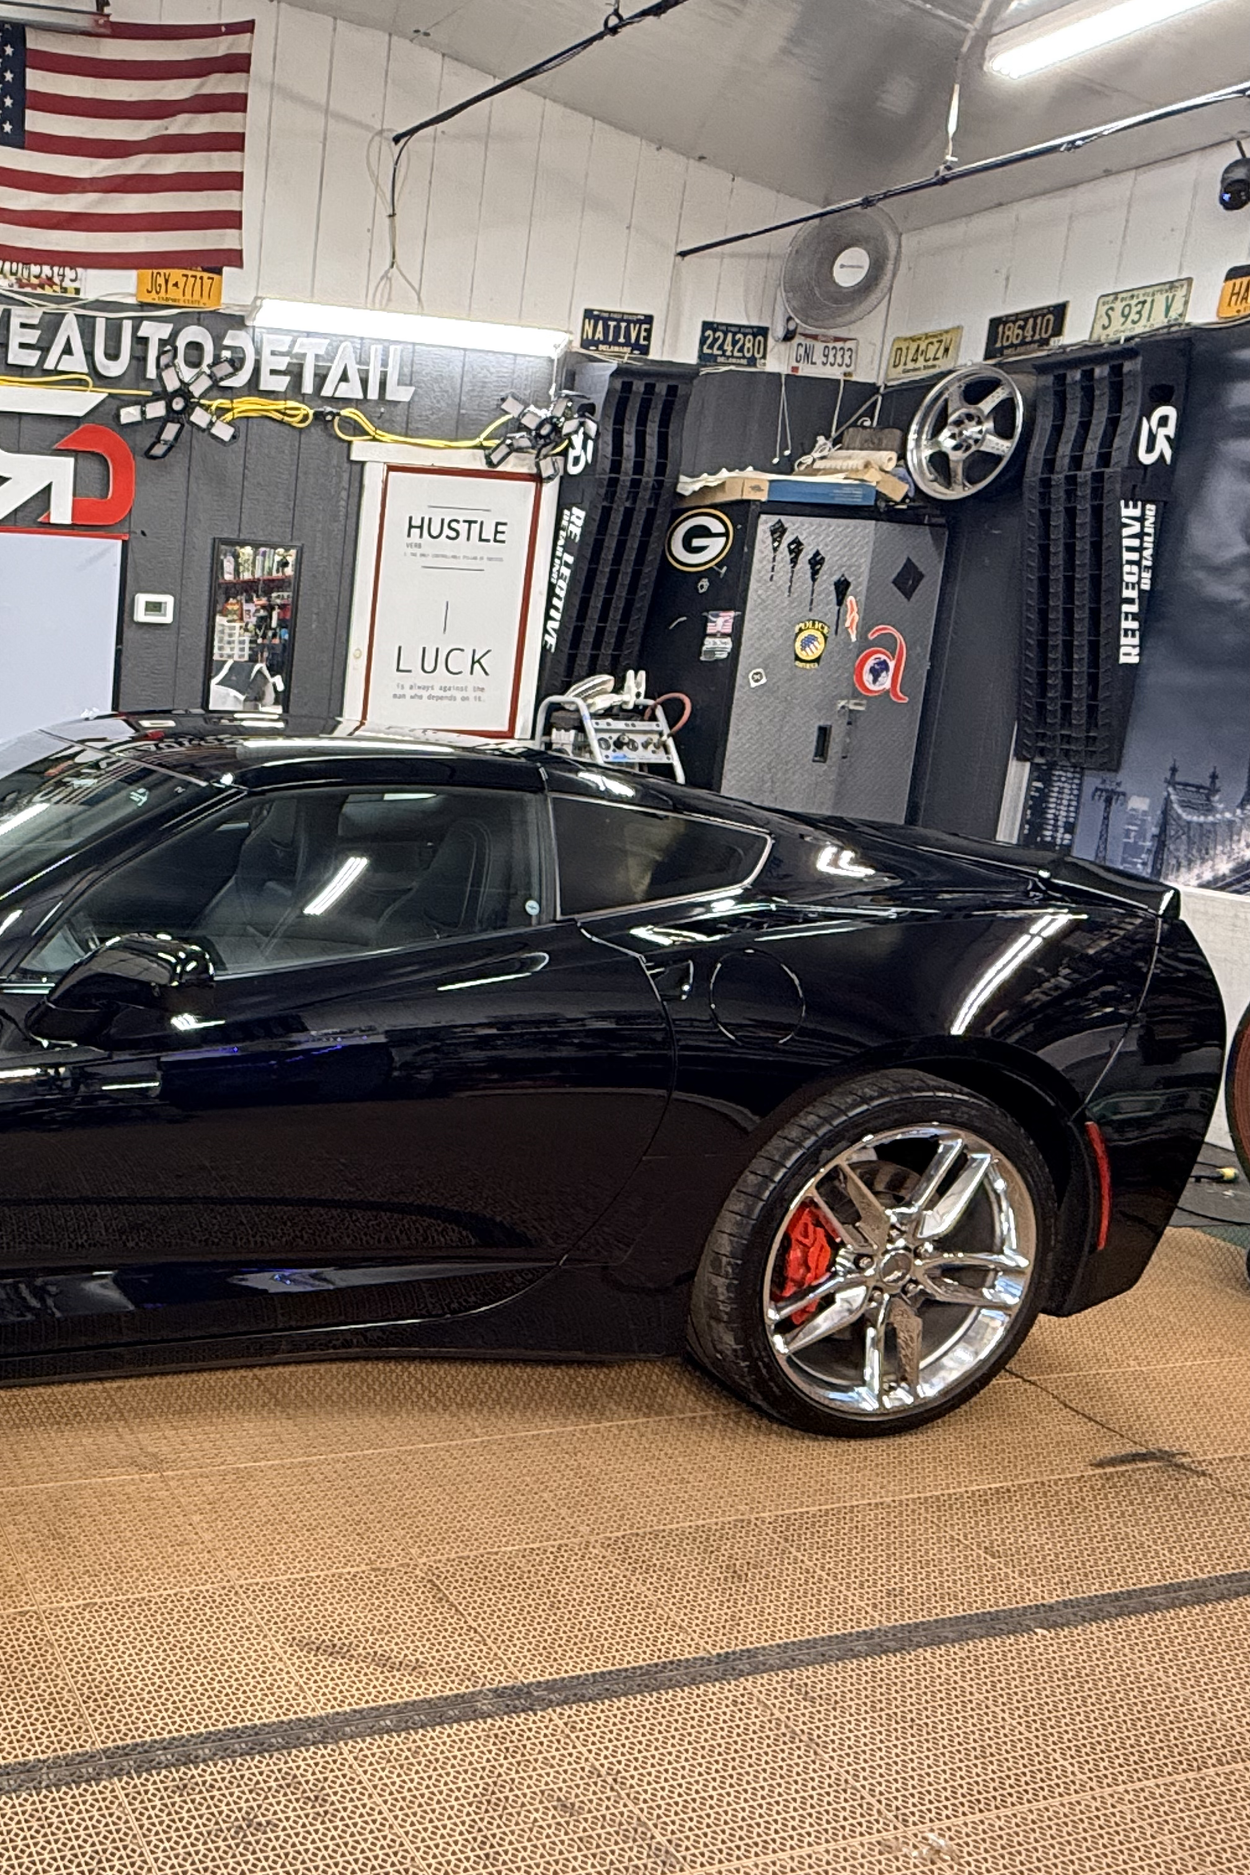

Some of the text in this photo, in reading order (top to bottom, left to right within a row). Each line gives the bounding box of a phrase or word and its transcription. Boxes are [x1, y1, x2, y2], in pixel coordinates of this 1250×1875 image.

[582, 318, 651, 345] NATIVE
[702, 329, 764, 358] 224280
[994, 313, 1055, 348] 186410
[794, 342, 854, 368] GNL 9333
[406, 515, 508, 544] HUSTLE
[1140, 503, 1157, 591] DETAILING
[1118, 499, 1143, 665] REFLECTIVE
[794, 619, 830, 635] POLICE
[395, 645, 492, 677] LUCK
[396, 682, 486, 693] is always against the
[409, 693, 424, 701] who
[426, 693, 457, 702] depends
